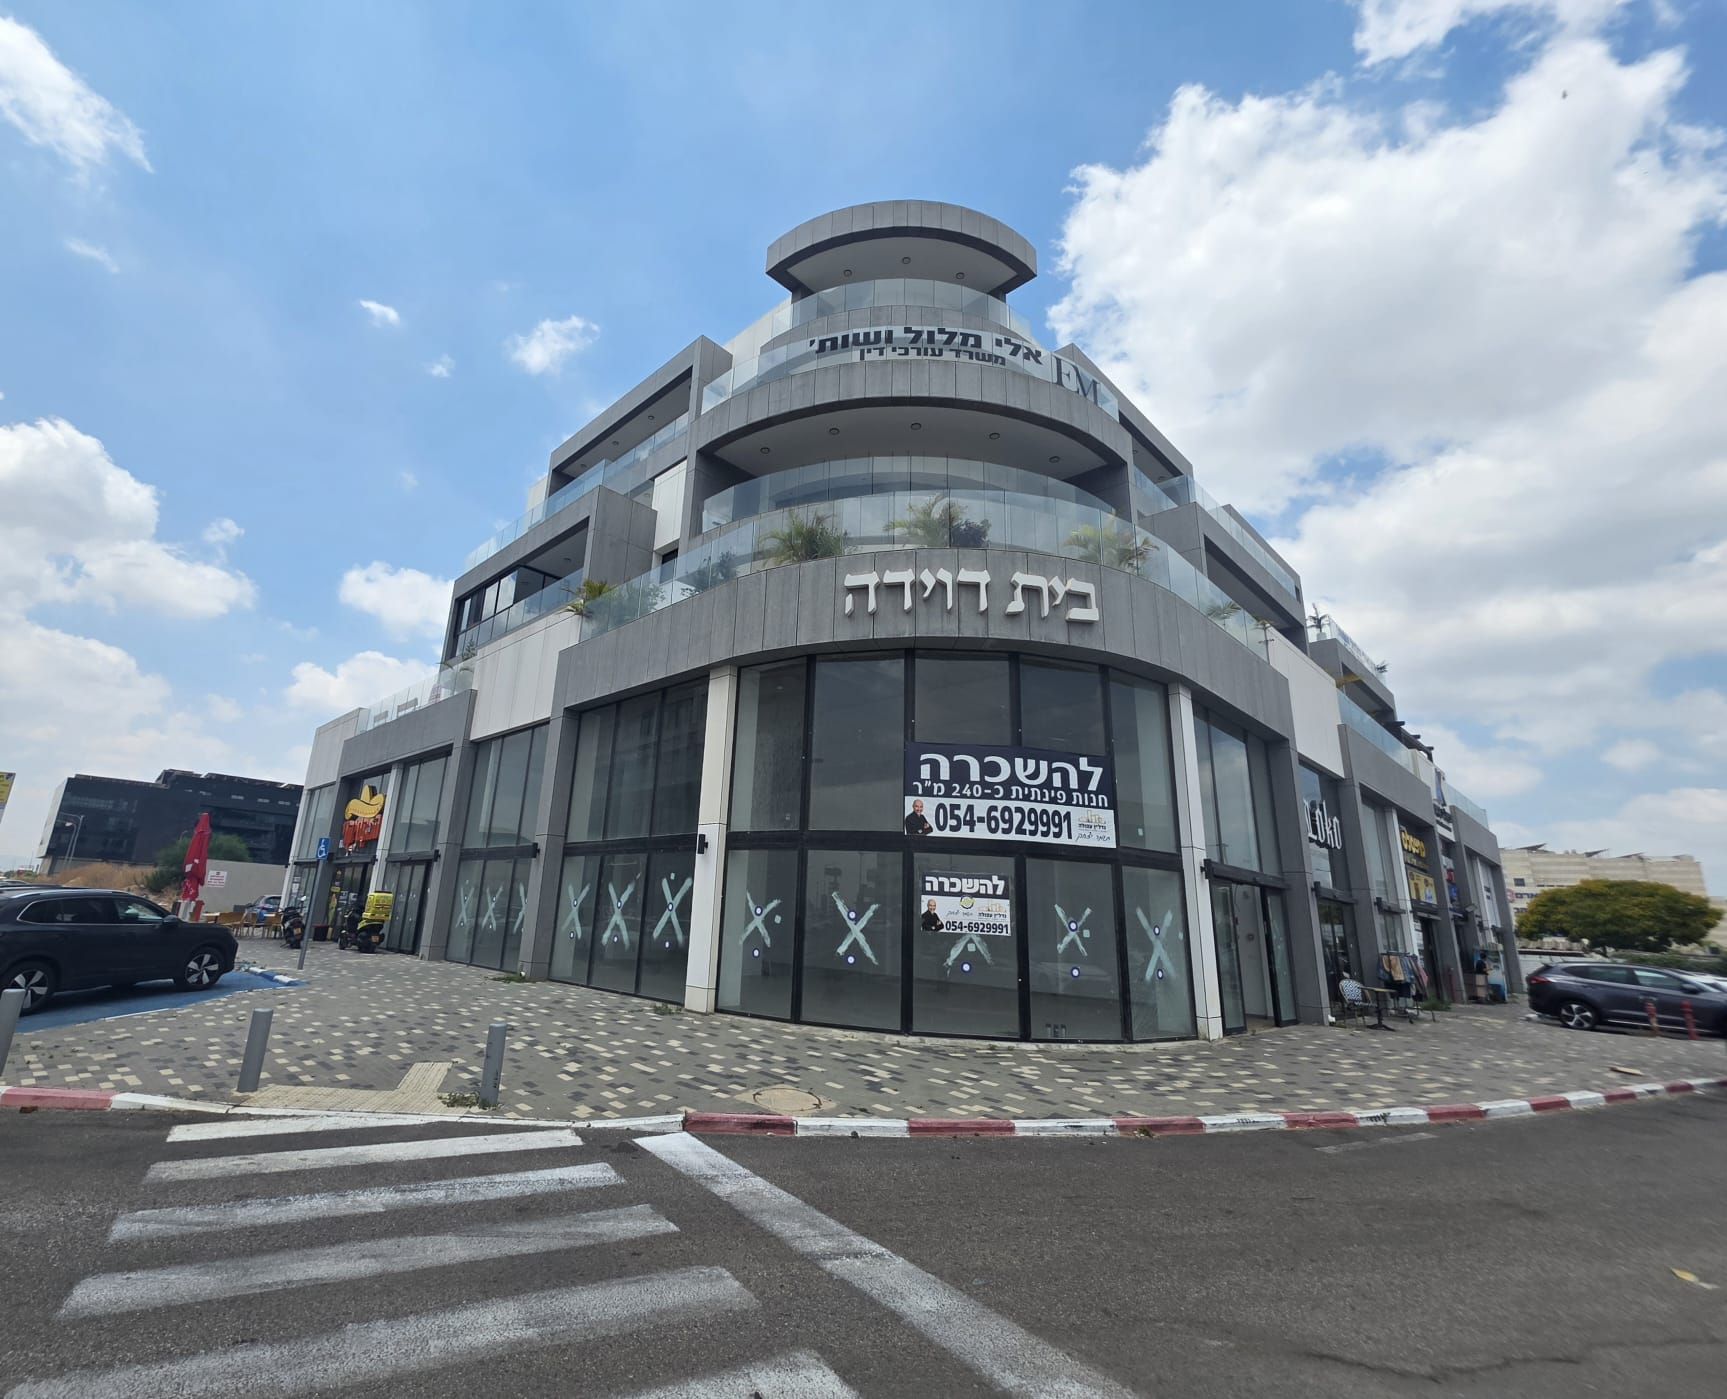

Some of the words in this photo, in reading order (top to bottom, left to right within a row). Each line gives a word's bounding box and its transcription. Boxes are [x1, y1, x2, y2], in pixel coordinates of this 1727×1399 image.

[903, 326, 982, 349] מלול
[859, 346, 885, 361] דין
[891, 346, 943, 357] עורכי
[949, 348, 1006, 367] משרד
[995, 337, 1043, 365] אלי
[843, 567, 991, 617] דוידה
[1005, 571, 1100, 623] בית
[919, 753, 1104, 791] להשכרה
[1010, 785, 1067, 803] פינתית
[1072, 791, 1109, 808] חנות
[934, 802, 1073, 840] 054-6929991
[925, 875, 1005, 895] להשכרה
[945, 920, 1009, 934] 054-6929991
